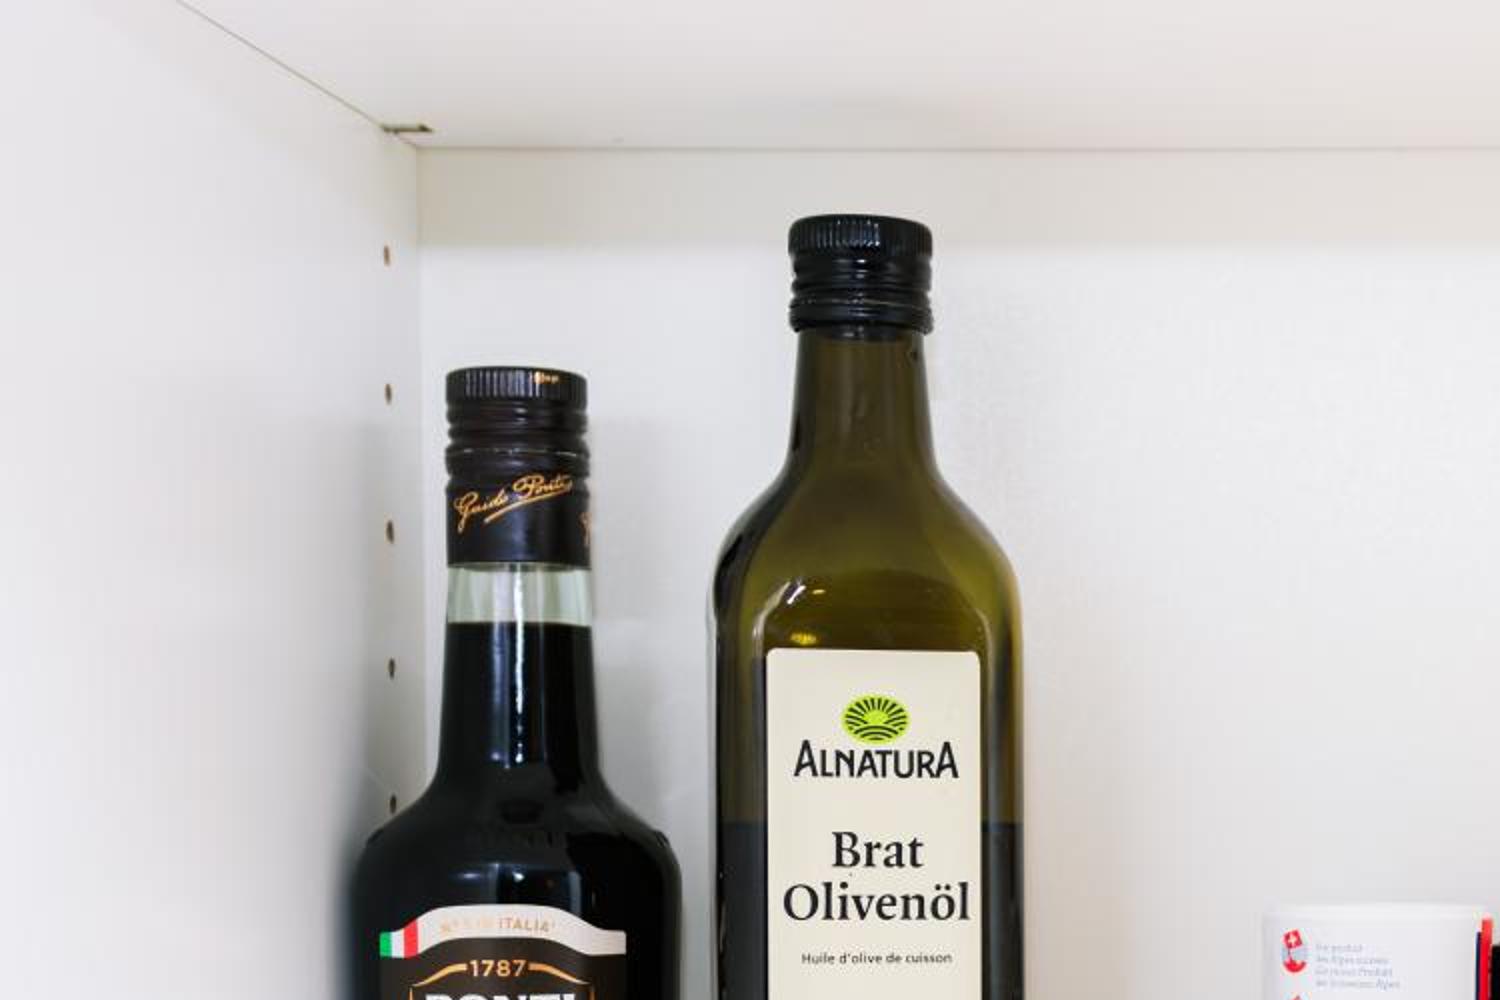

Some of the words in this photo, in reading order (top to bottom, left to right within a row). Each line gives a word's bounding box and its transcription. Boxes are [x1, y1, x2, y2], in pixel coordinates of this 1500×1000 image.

[831, 831, 925, 869] Brat
[783, 880, 971, 922] Olivenöl
[469, 959, 528, 977] 1787
[801, 952, 835, 965] Huile
[839, 952, 883, 965] d'olive
[885, 952, 902, 965] de
[904, 953, 953, 964] cuisson
